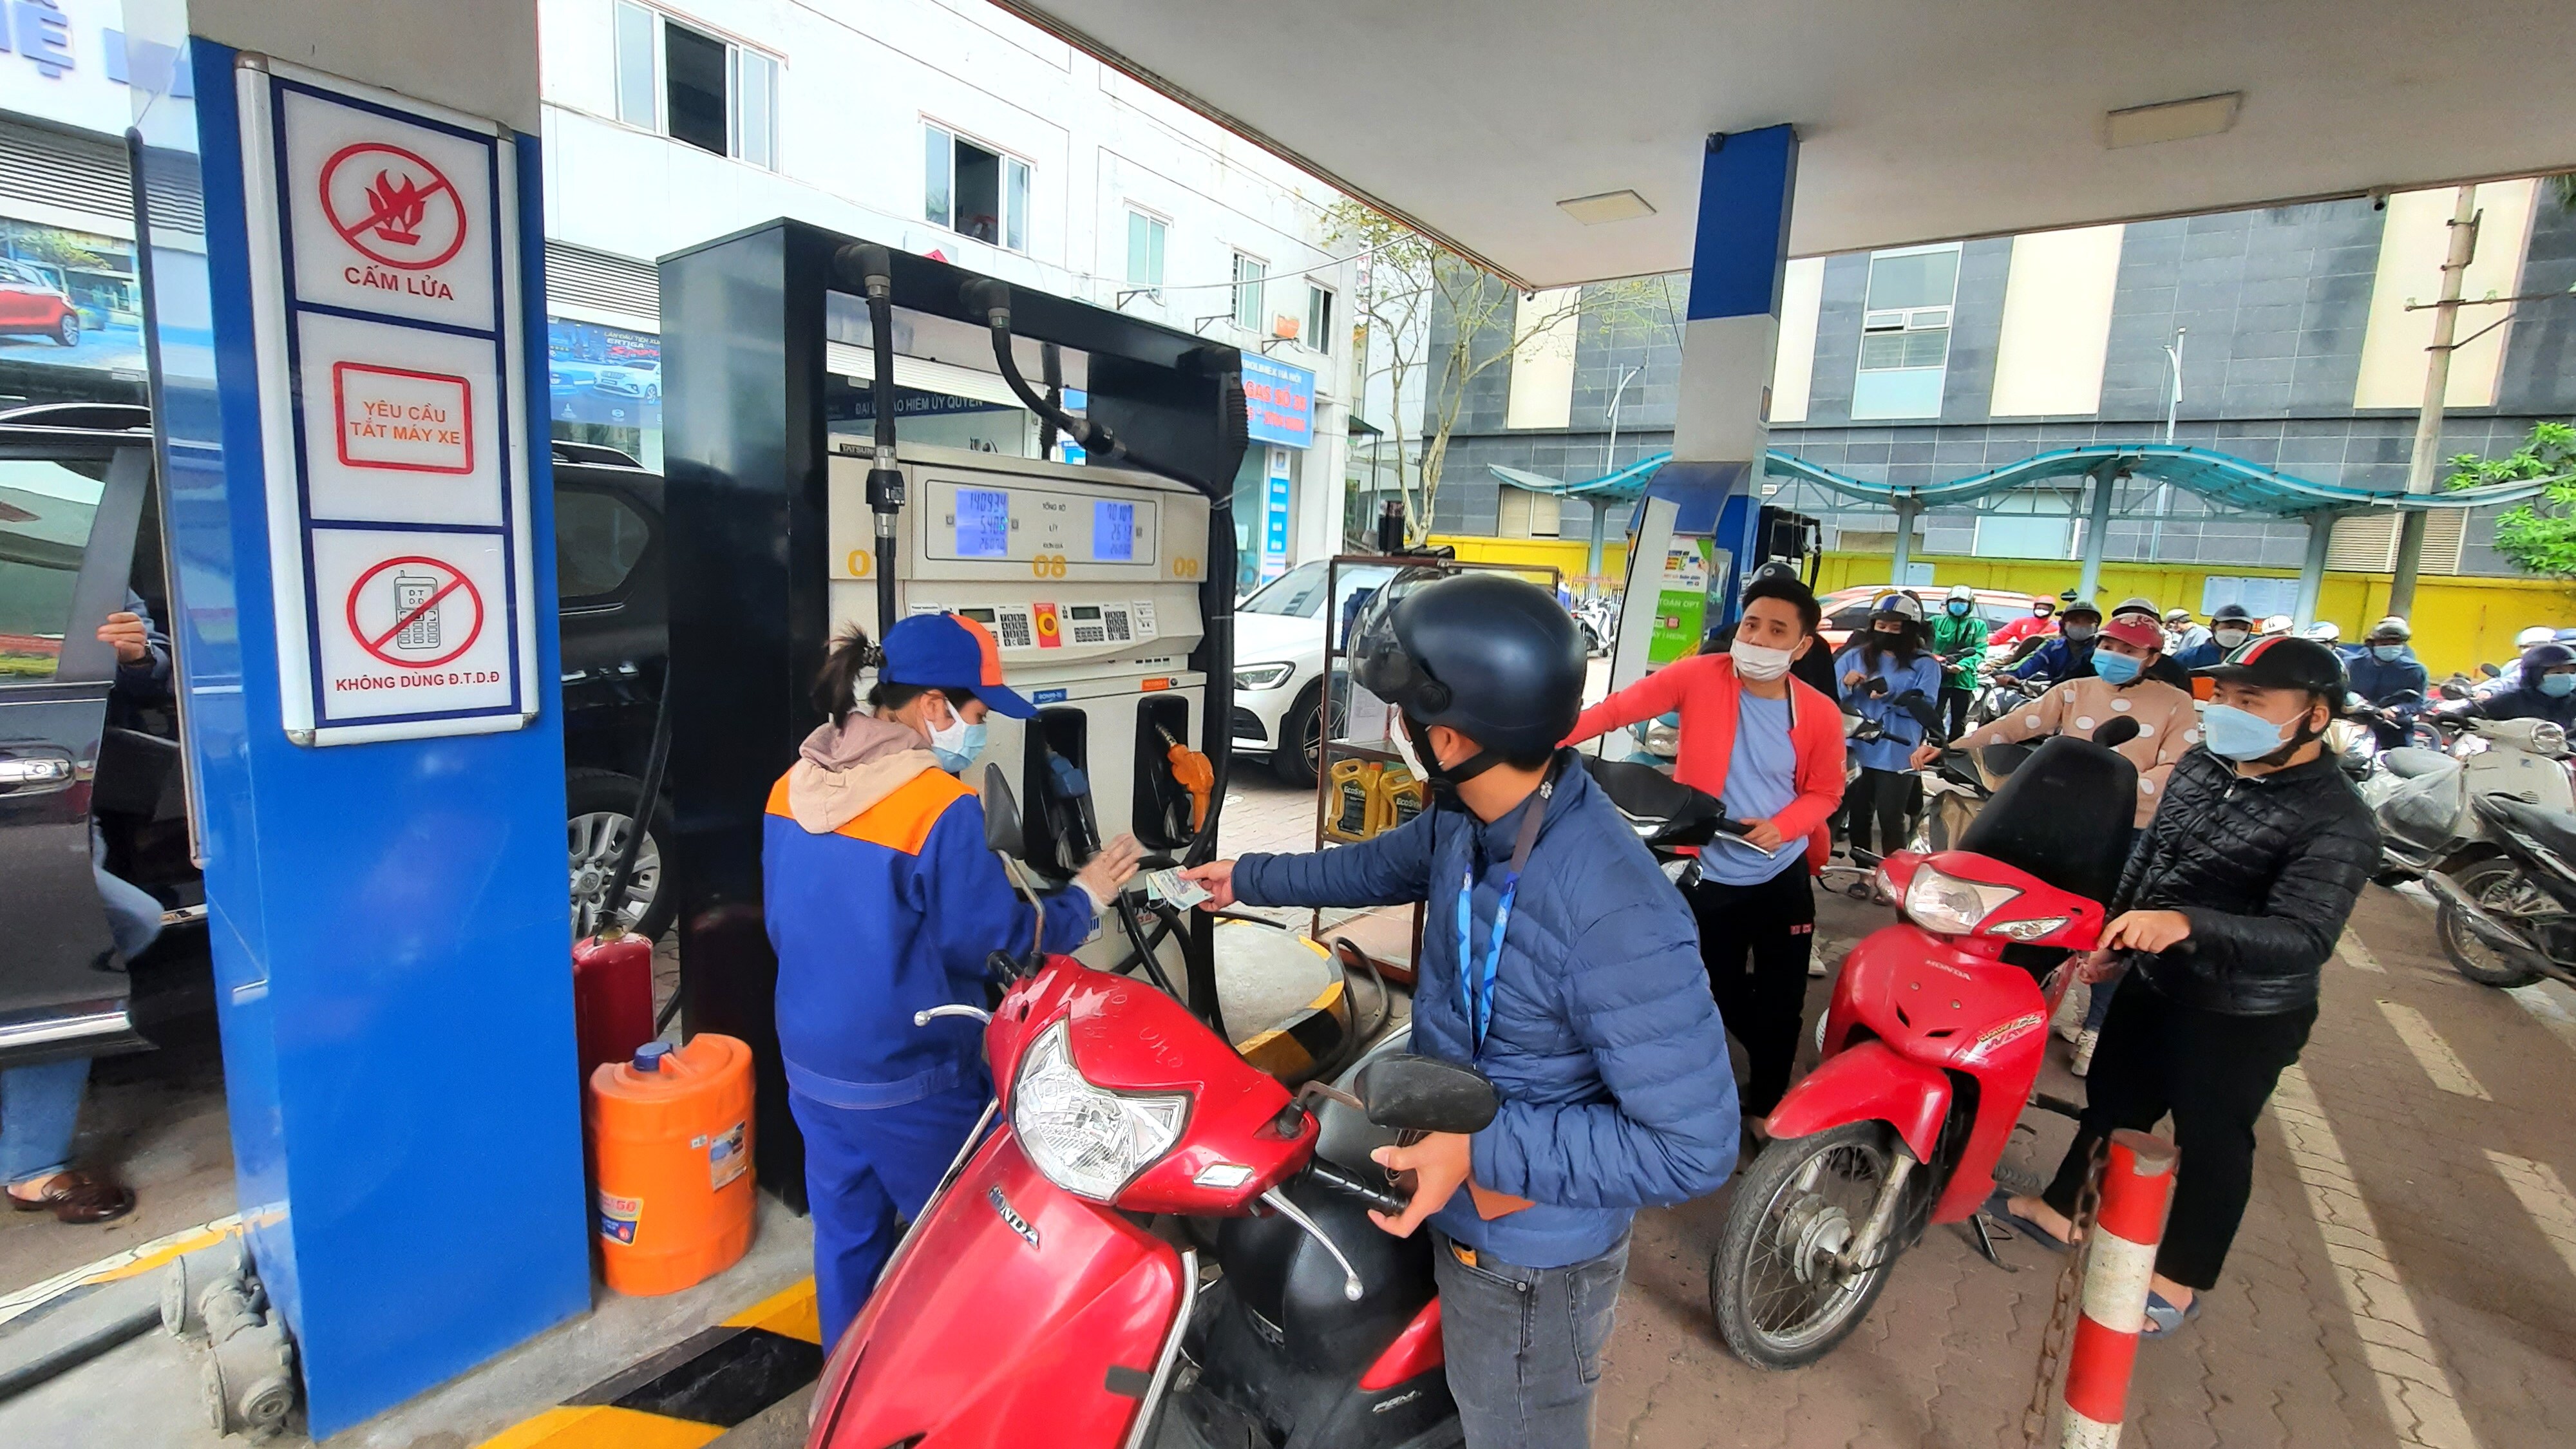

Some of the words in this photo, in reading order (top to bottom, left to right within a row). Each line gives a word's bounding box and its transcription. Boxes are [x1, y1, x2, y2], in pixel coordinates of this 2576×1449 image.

[345, 265, 399, 291] CẤM
[407, 274, 454, 301] LỬA
[607, 337, 645, 349] ERTIGA
[363, 400, 402, 419] YÊU
[408, 402, 446, 423] CẦU
[350, 417, 387, 439] TẮT
[393, 424, 433, 442] MÁY
[438, 430, 461, 445] XE
[842, 444, 876, 455] TATSUN
[848, 549, 871, 577] 0
[1034, 554, 1067, 578] 08
[336, 674, 395, 691] KHÔNG
[401, 671, 444, 687] DÙNG
[449, 671, 500, 685] Đ.T.D.Đ
[1926, 959, 1972, 981] HONDA
[988, 1184, 1041, 1250] HONDA
